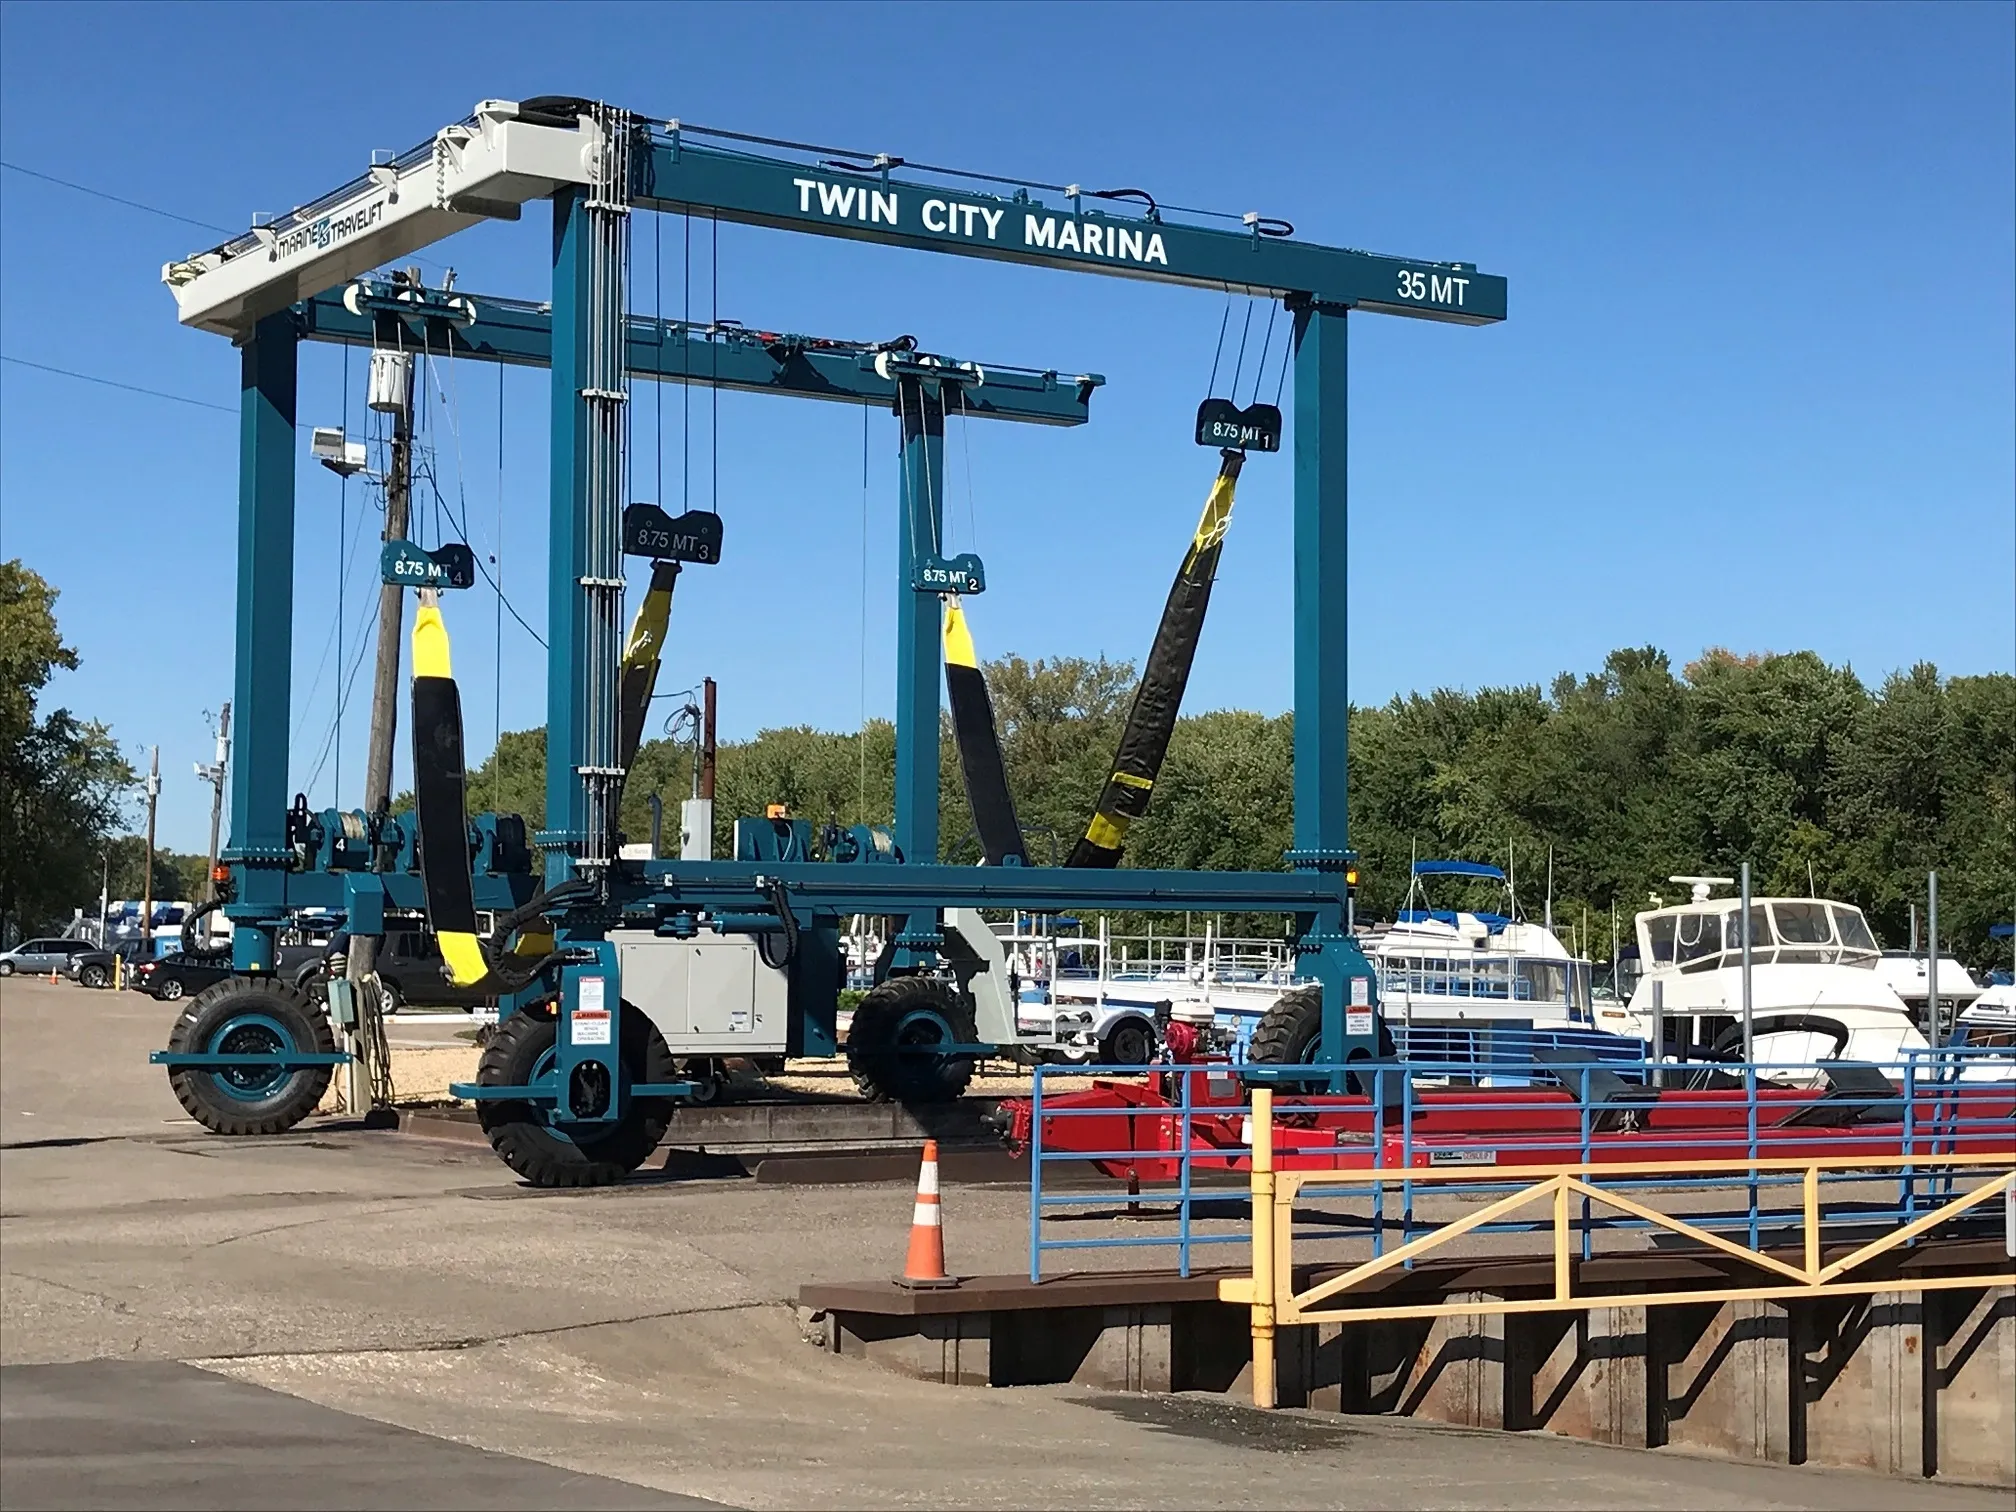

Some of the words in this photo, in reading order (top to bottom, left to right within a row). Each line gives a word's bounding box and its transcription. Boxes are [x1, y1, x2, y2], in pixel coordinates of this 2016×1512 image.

[278, 224, 317, 260] MARINE
[330, 200, 384, 243] TRAVELIFT
[793, 178, 898, 225] TWIN
[921, 199, 1005, 240] CITY
[1024, 214, 1169, 266] MARINA
[1397, 269, 1426, 300] 35
[1431, 274, 1470, 306] MT
[1213, 421, 1238, 438] 8.75
[1241, 425, 1262, 441] MT
[1263, 435, 1269, 448] 1
[637, 529, 669, 548] 8.75
[672, 533, 699, 552] MT
[698, 544, 709, 560] 3
[394, 560, 424, 576] 8.75
[428, 562, 451, 577] MT
[453, 571, 463, 584] 4
[923, 568, 947, 583] 8.75
[949, 570, 968, 584] MT
[969, 578, 978, 590] 2
[335, 838, 346, 852] 4
